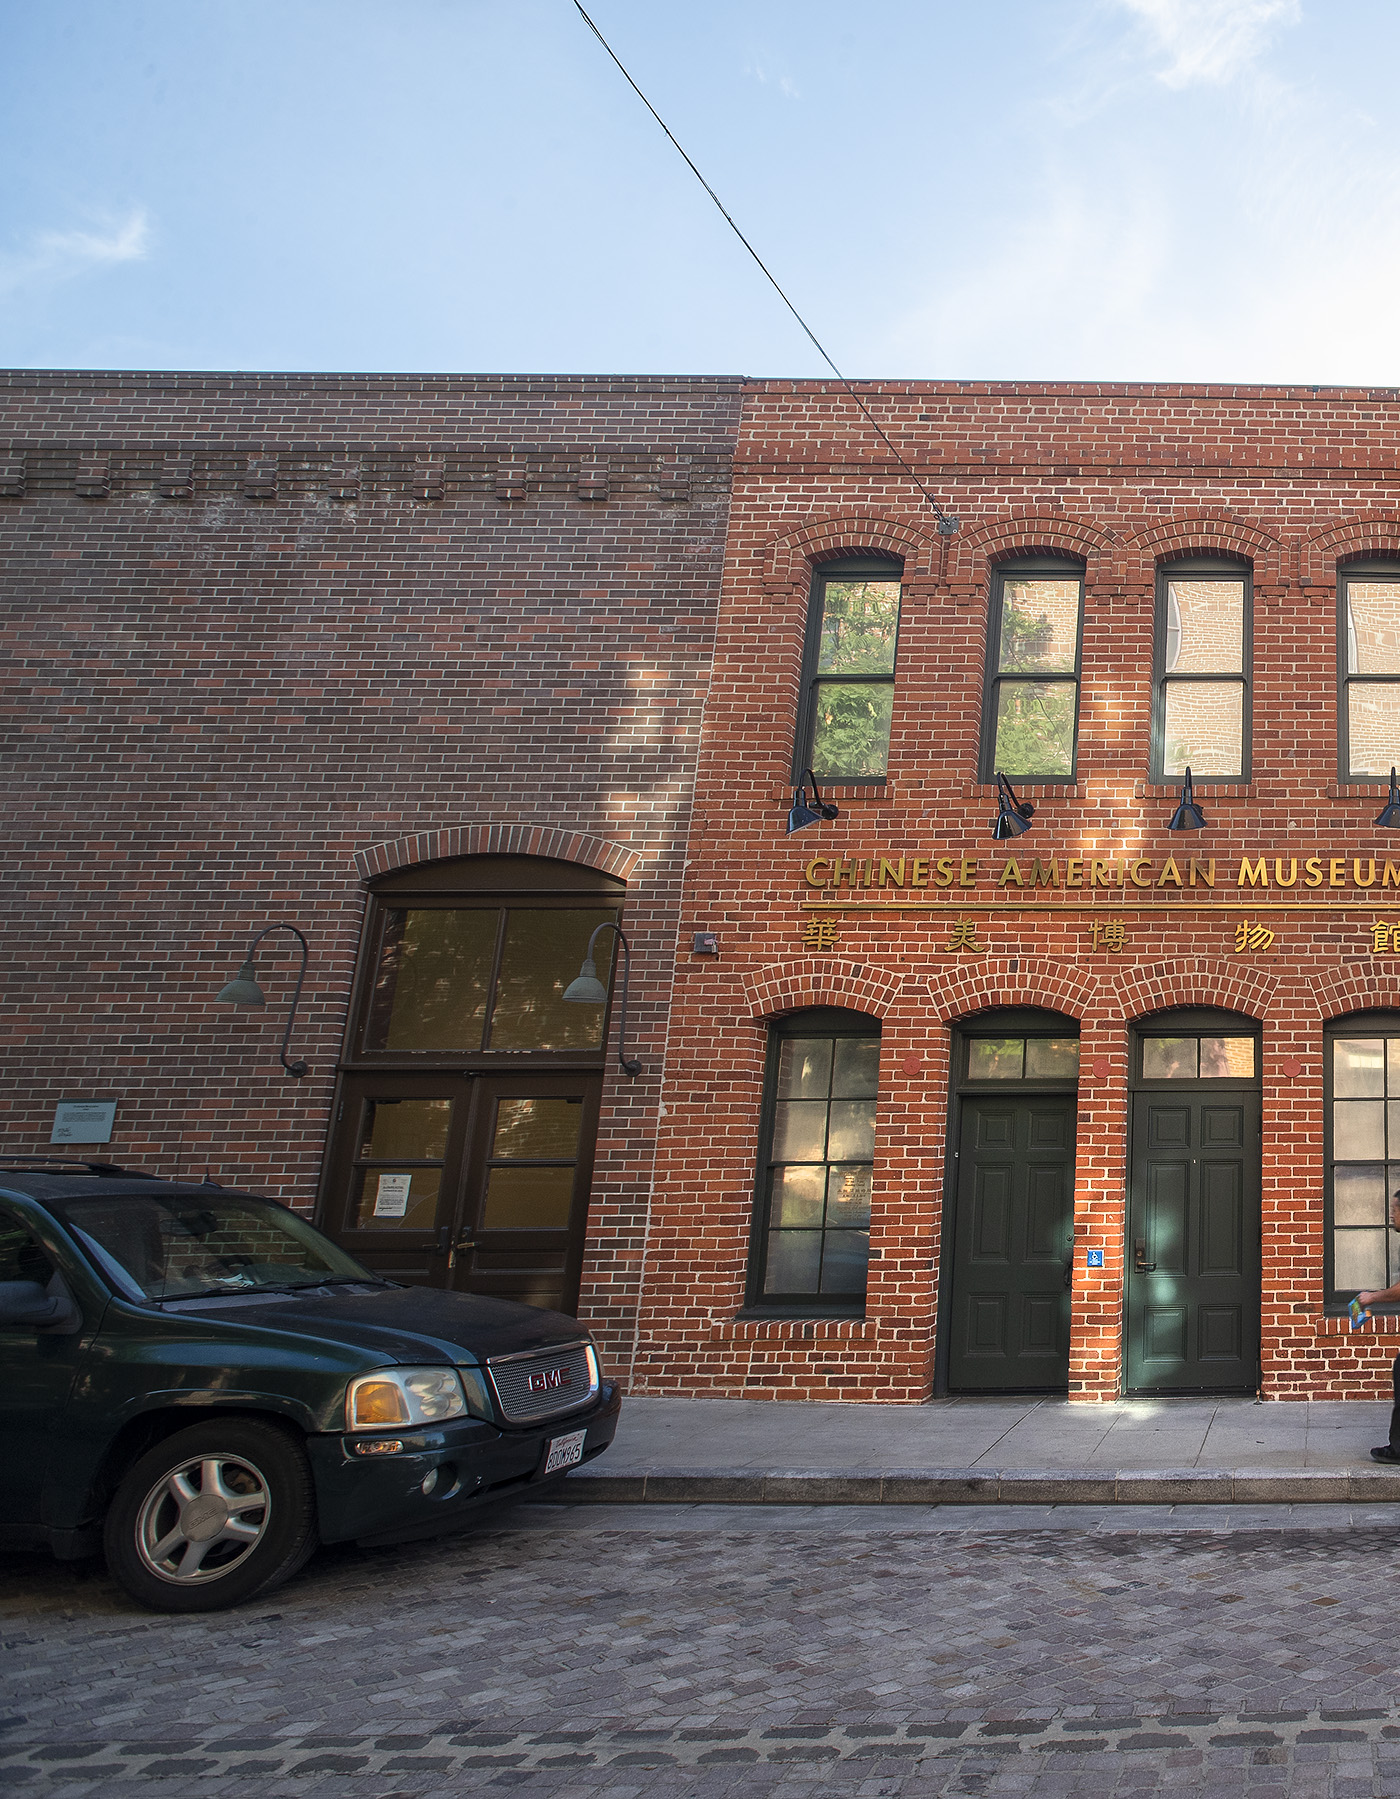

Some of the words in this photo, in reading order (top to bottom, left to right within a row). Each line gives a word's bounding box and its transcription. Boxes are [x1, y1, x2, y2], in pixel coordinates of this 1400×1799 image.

[805, 857, 978, 887] CHINESE
[998, 857, 1216, 887] AMERICAN
[528, 1368, 571, 1391] GMC
